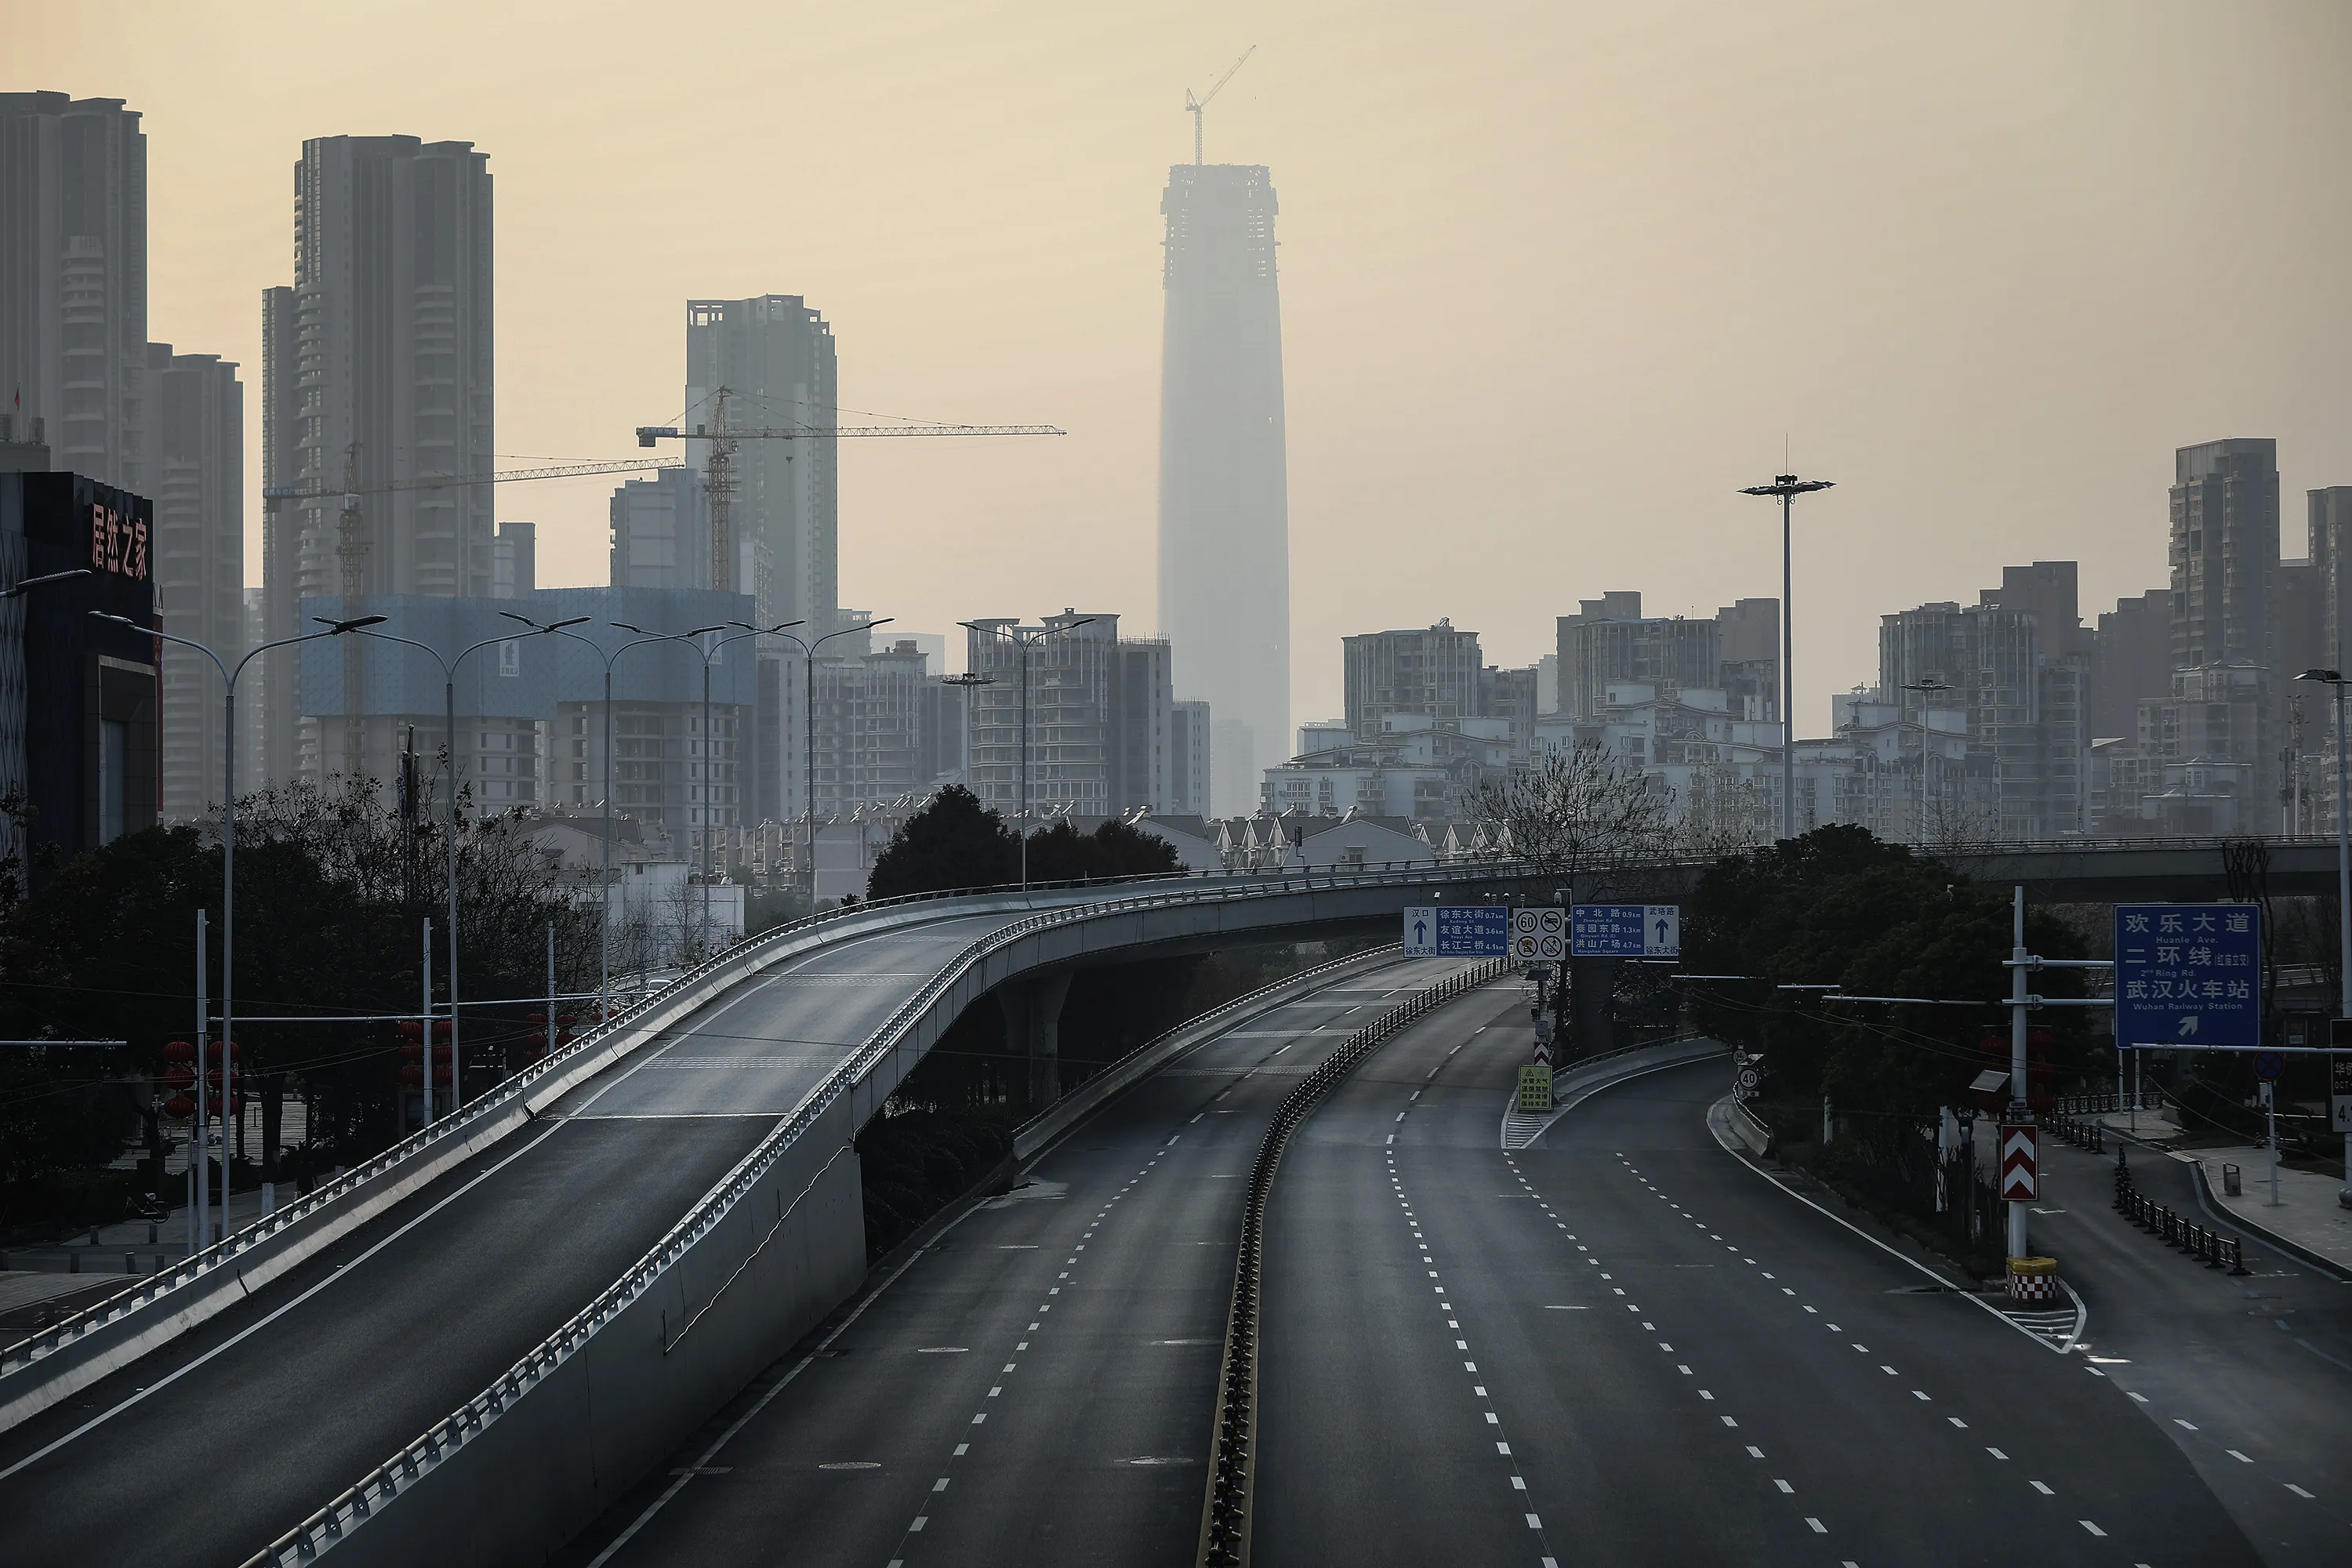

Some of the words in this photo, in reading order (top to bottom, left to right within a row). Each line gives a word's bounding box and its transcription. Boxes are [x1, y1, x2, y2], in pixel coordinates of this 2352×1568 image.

[92, 503, 147, 581] 居然之家
[1440, 909, 1483, 919] 徐东大街
[1576, 909, 1620, 917] 中北路
[1650, 907, 1675, 916] 武珞路
[1521, 917, 1533, 927] 60
[2125, 913, 2249, 933] 欢乐大道
[1440, 925, 1484, 935] 友谊大道
[1440, 941, 1484, 950] 长江二桥
[1576, 939, 1620, 948] 洪山广场
[2125, 946, 2212, 966] 二环线
[2125, 979, 2249, 1000] 武汉火车站
[1744, 1074, 1755, 1083] 40
